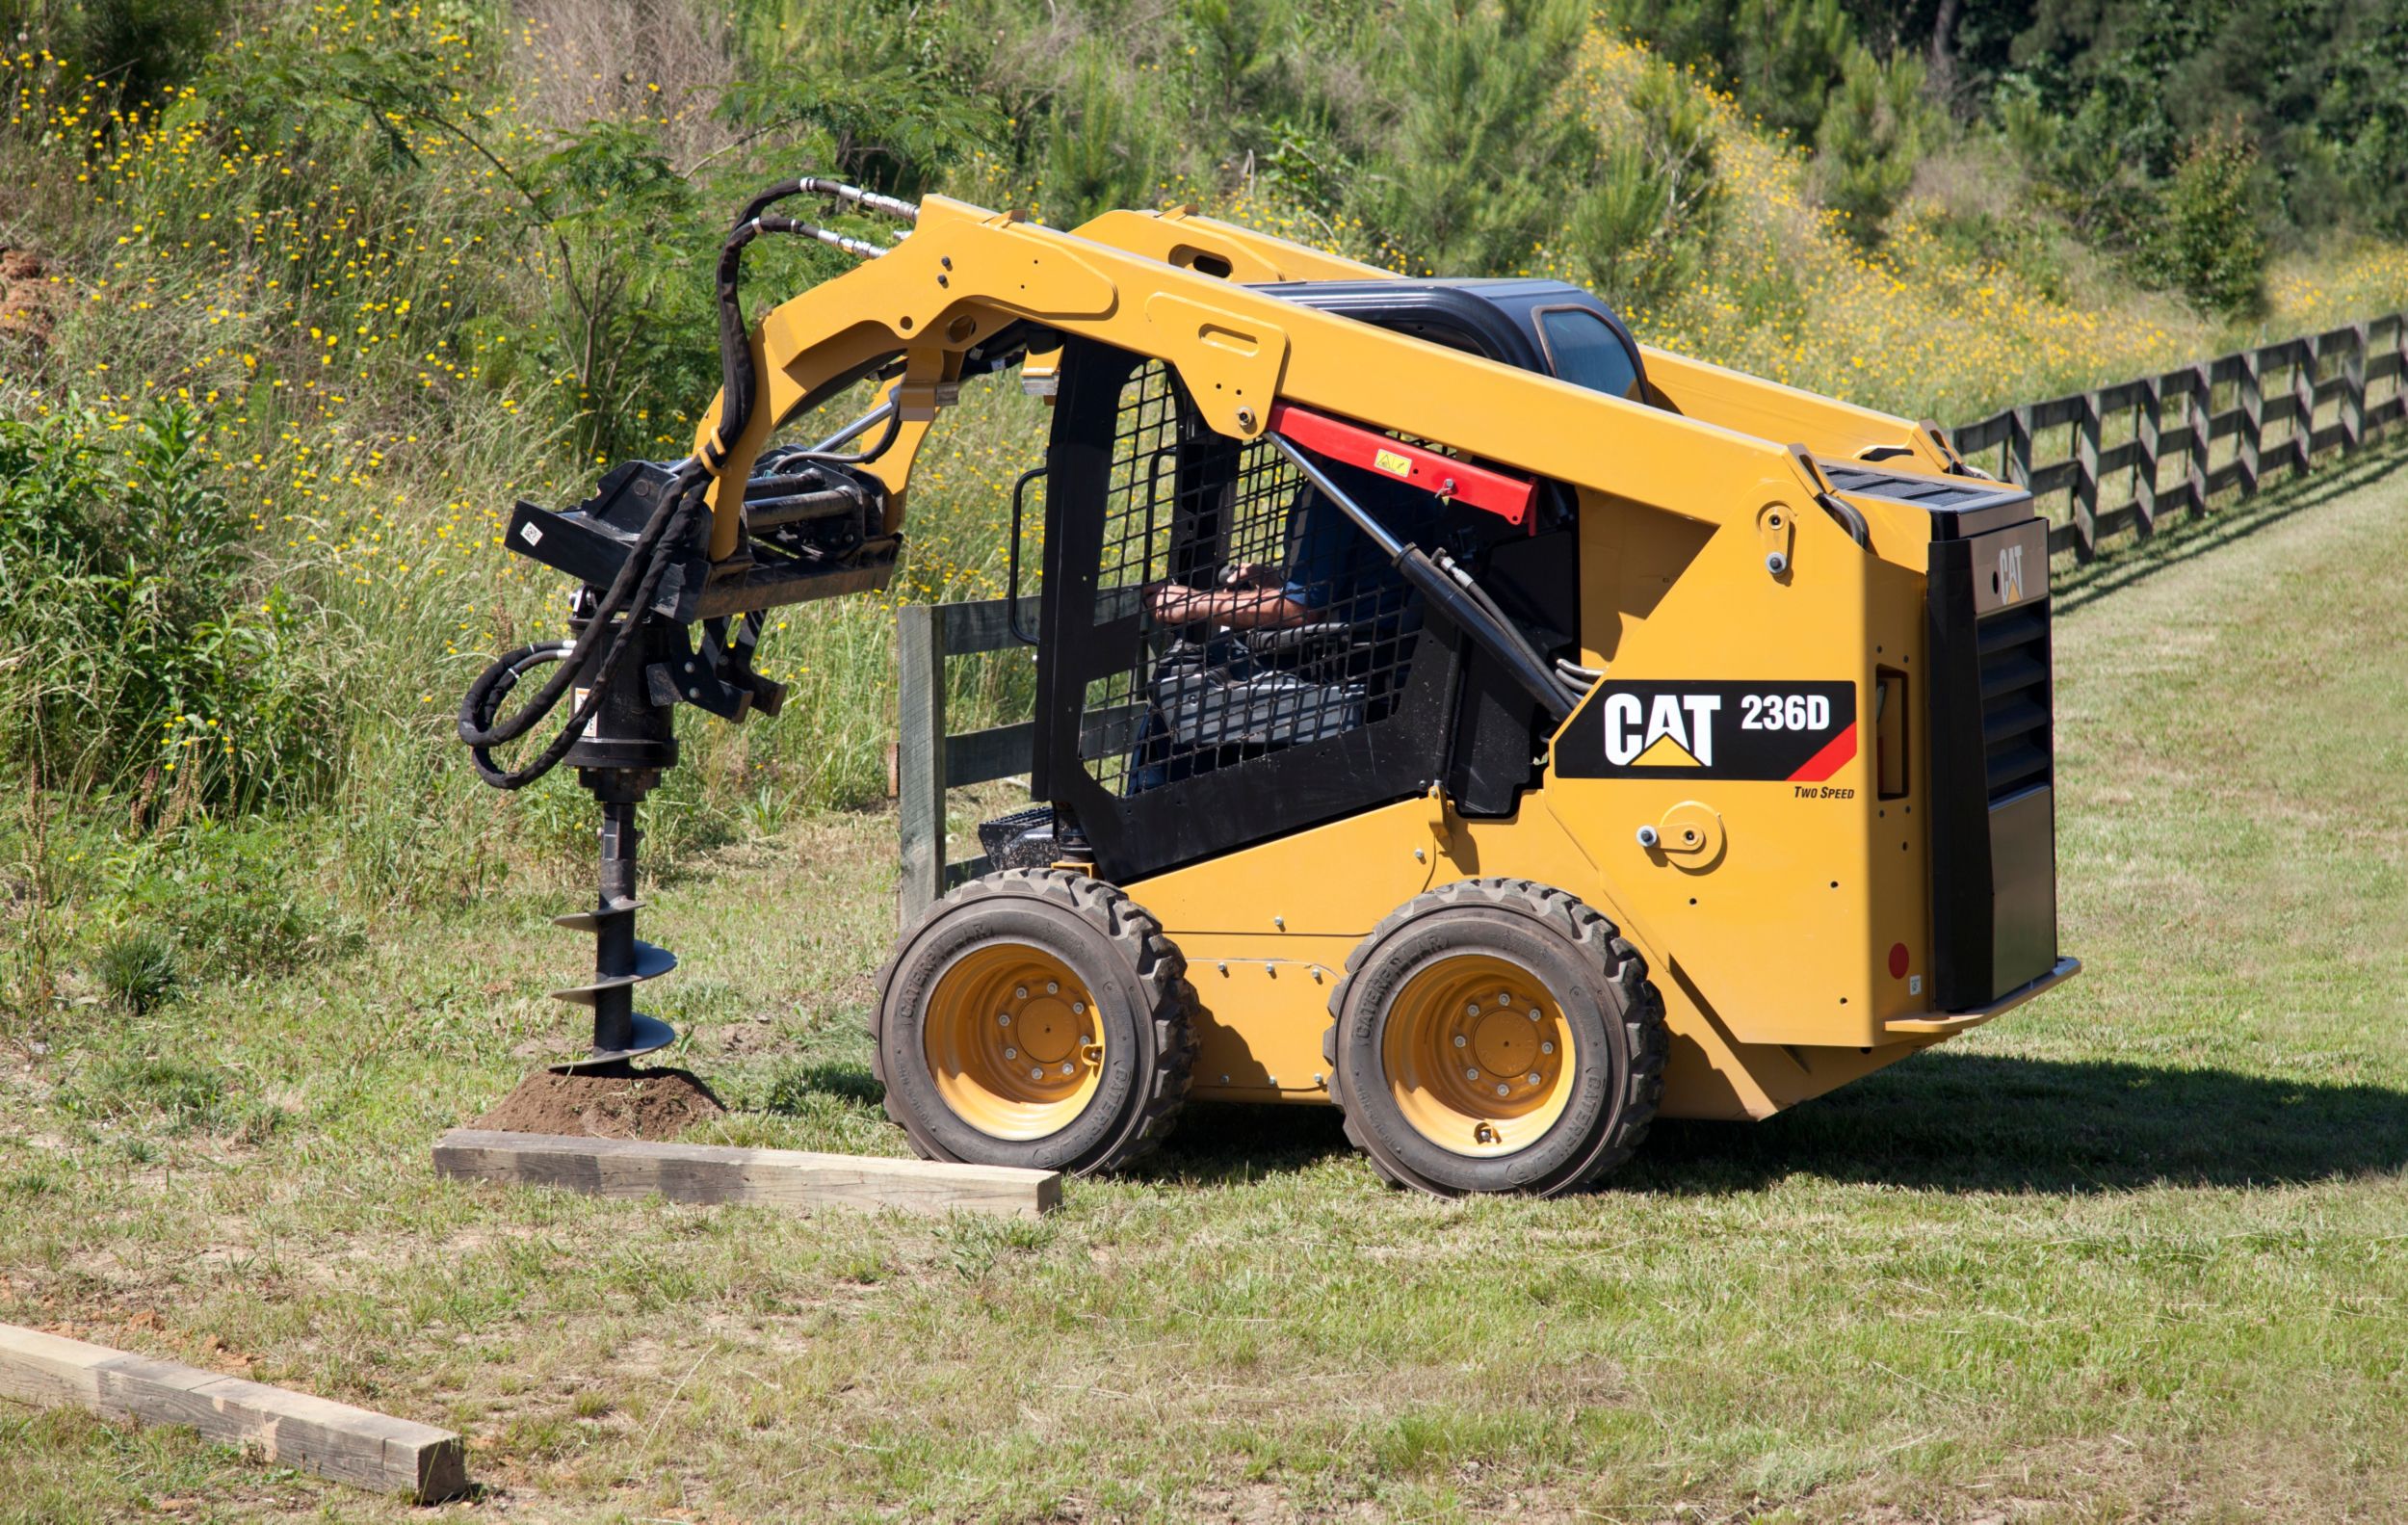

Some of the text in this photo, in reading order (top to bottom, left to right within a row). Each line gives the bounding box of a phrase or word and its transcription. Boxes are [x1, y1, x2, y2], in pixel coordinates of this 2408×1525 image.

[2000, 545, 2023, 605] CAT
[1604, 693, 1830, 767] CAT 236D
